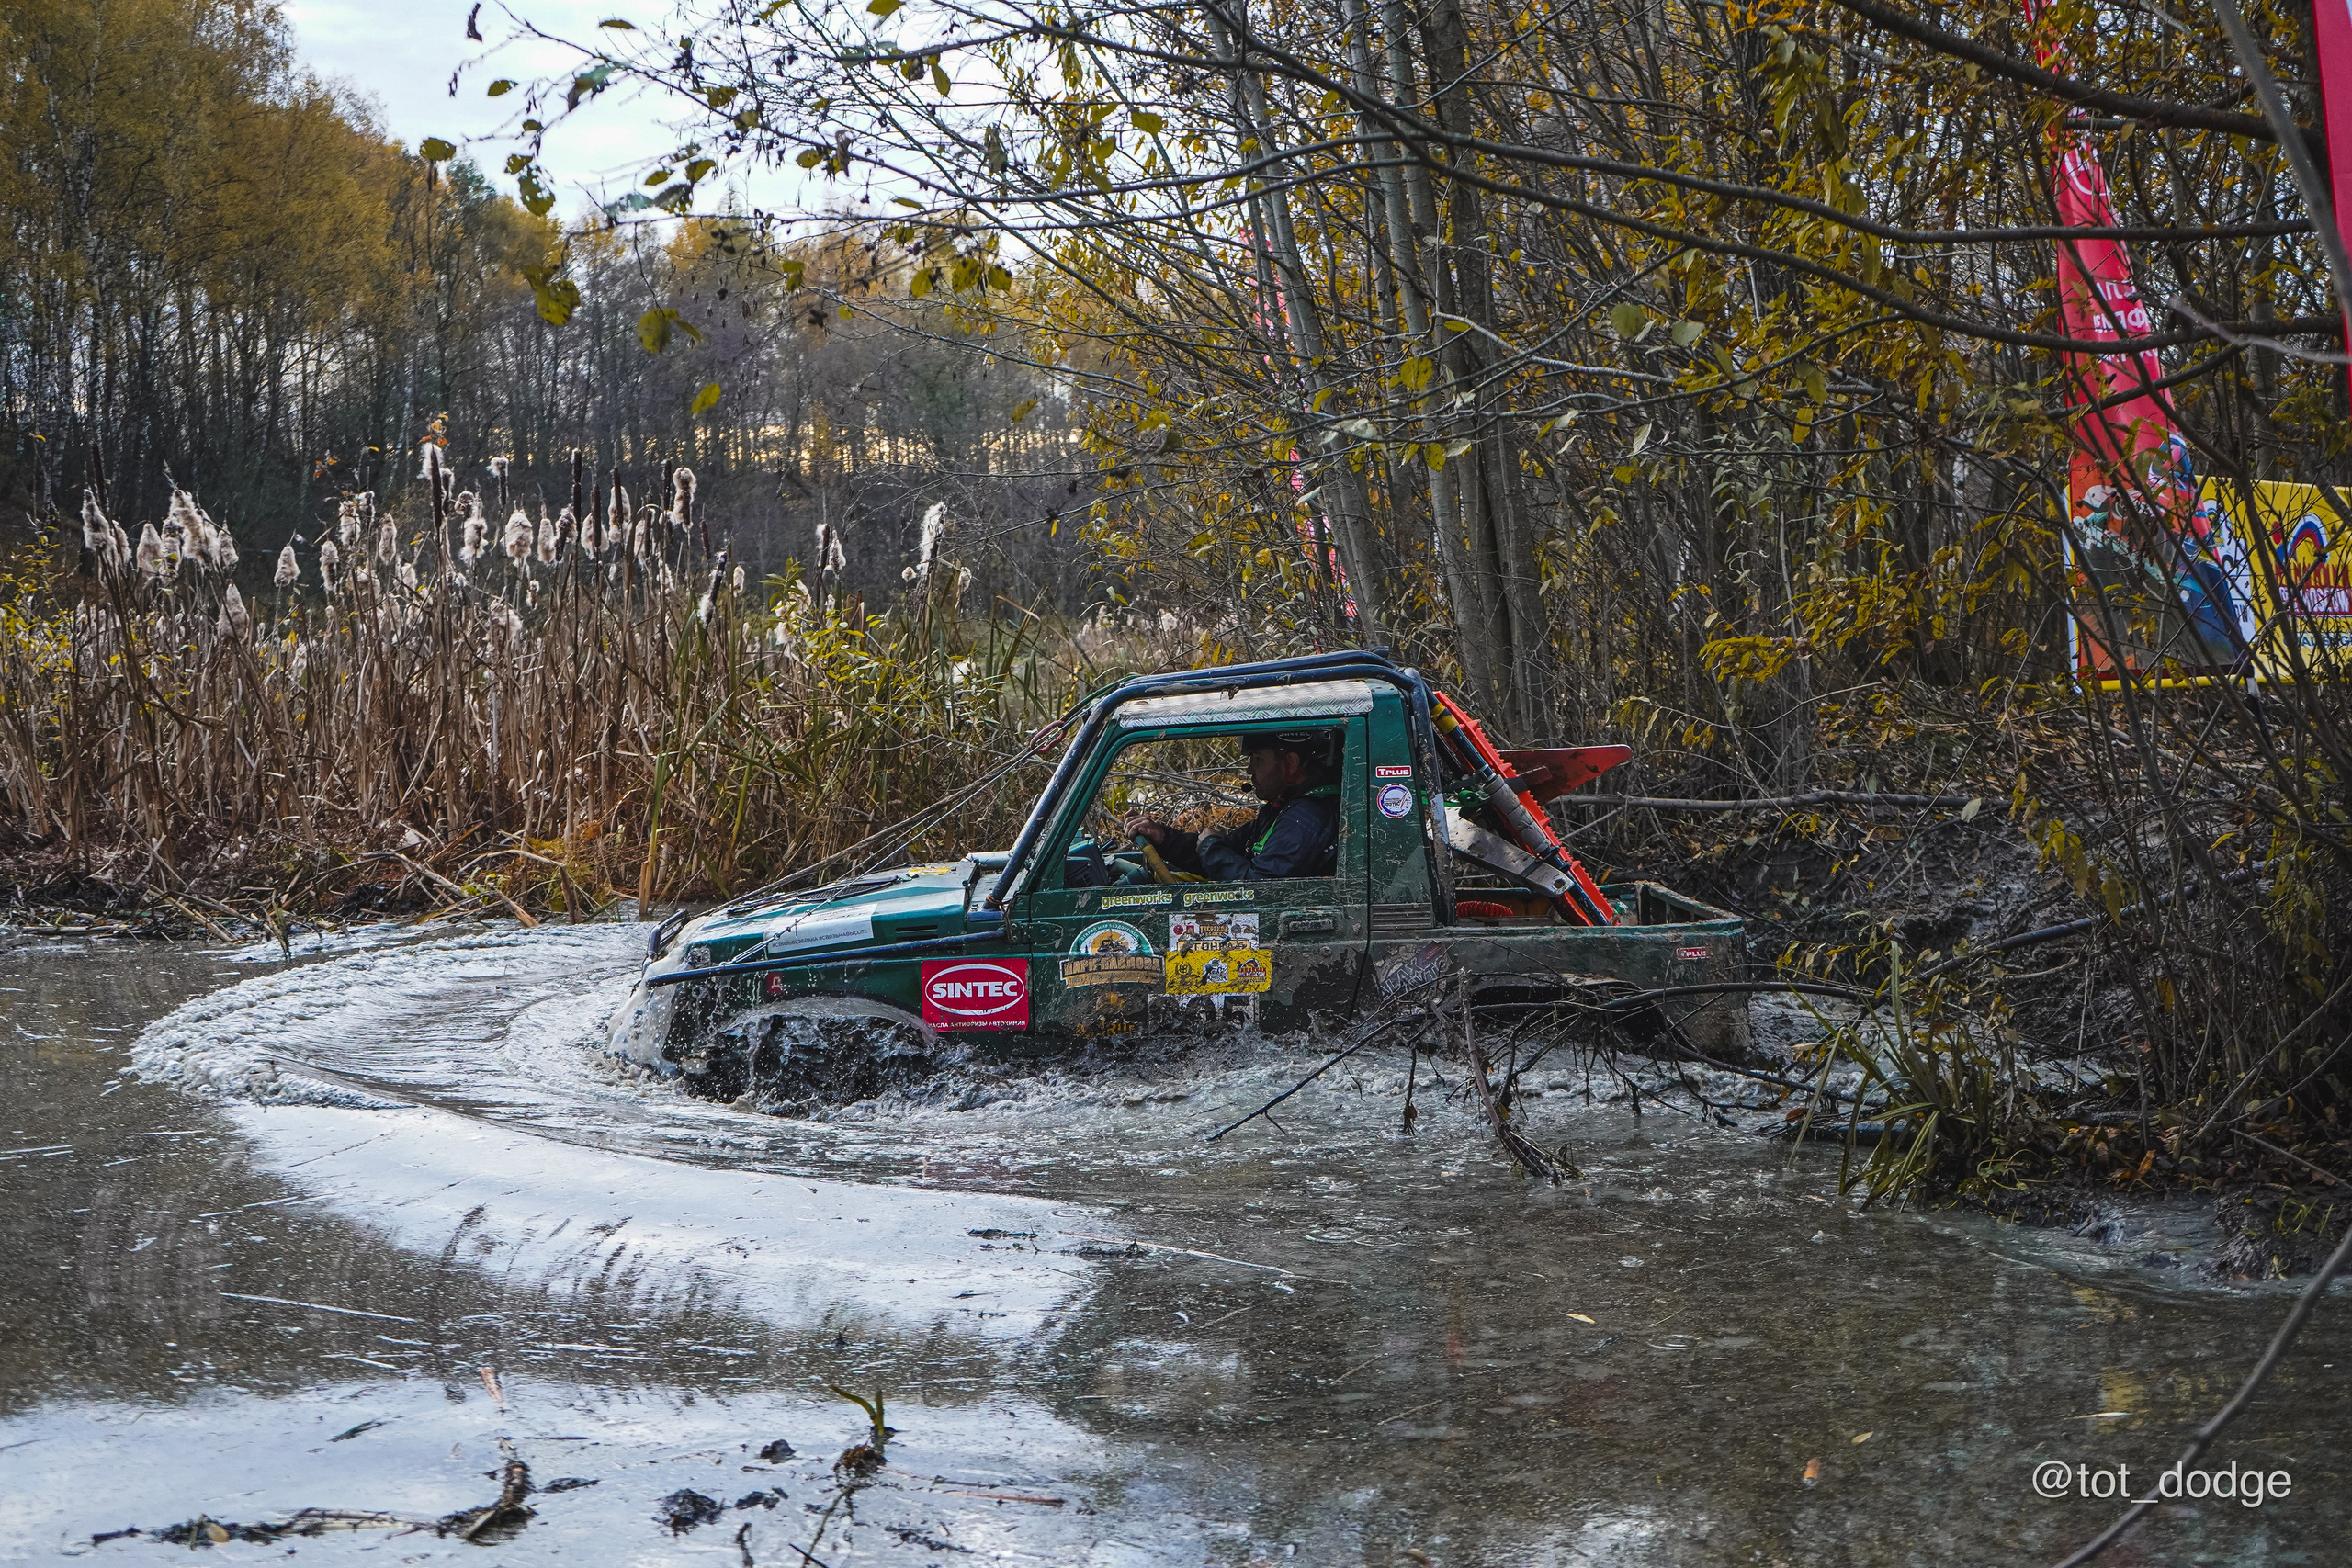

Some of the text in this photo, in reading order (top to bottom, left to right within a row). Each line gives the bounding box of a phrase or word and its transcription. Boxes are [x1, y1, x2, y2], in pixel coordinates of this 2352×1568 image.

[1377, 768, 1409, 776] TPLUS
[1102, 891, 1172, 908] greenworks
[1183, 887, 1254, 907] greenwoks
[932, 981, 1018, 998] SINTEC
